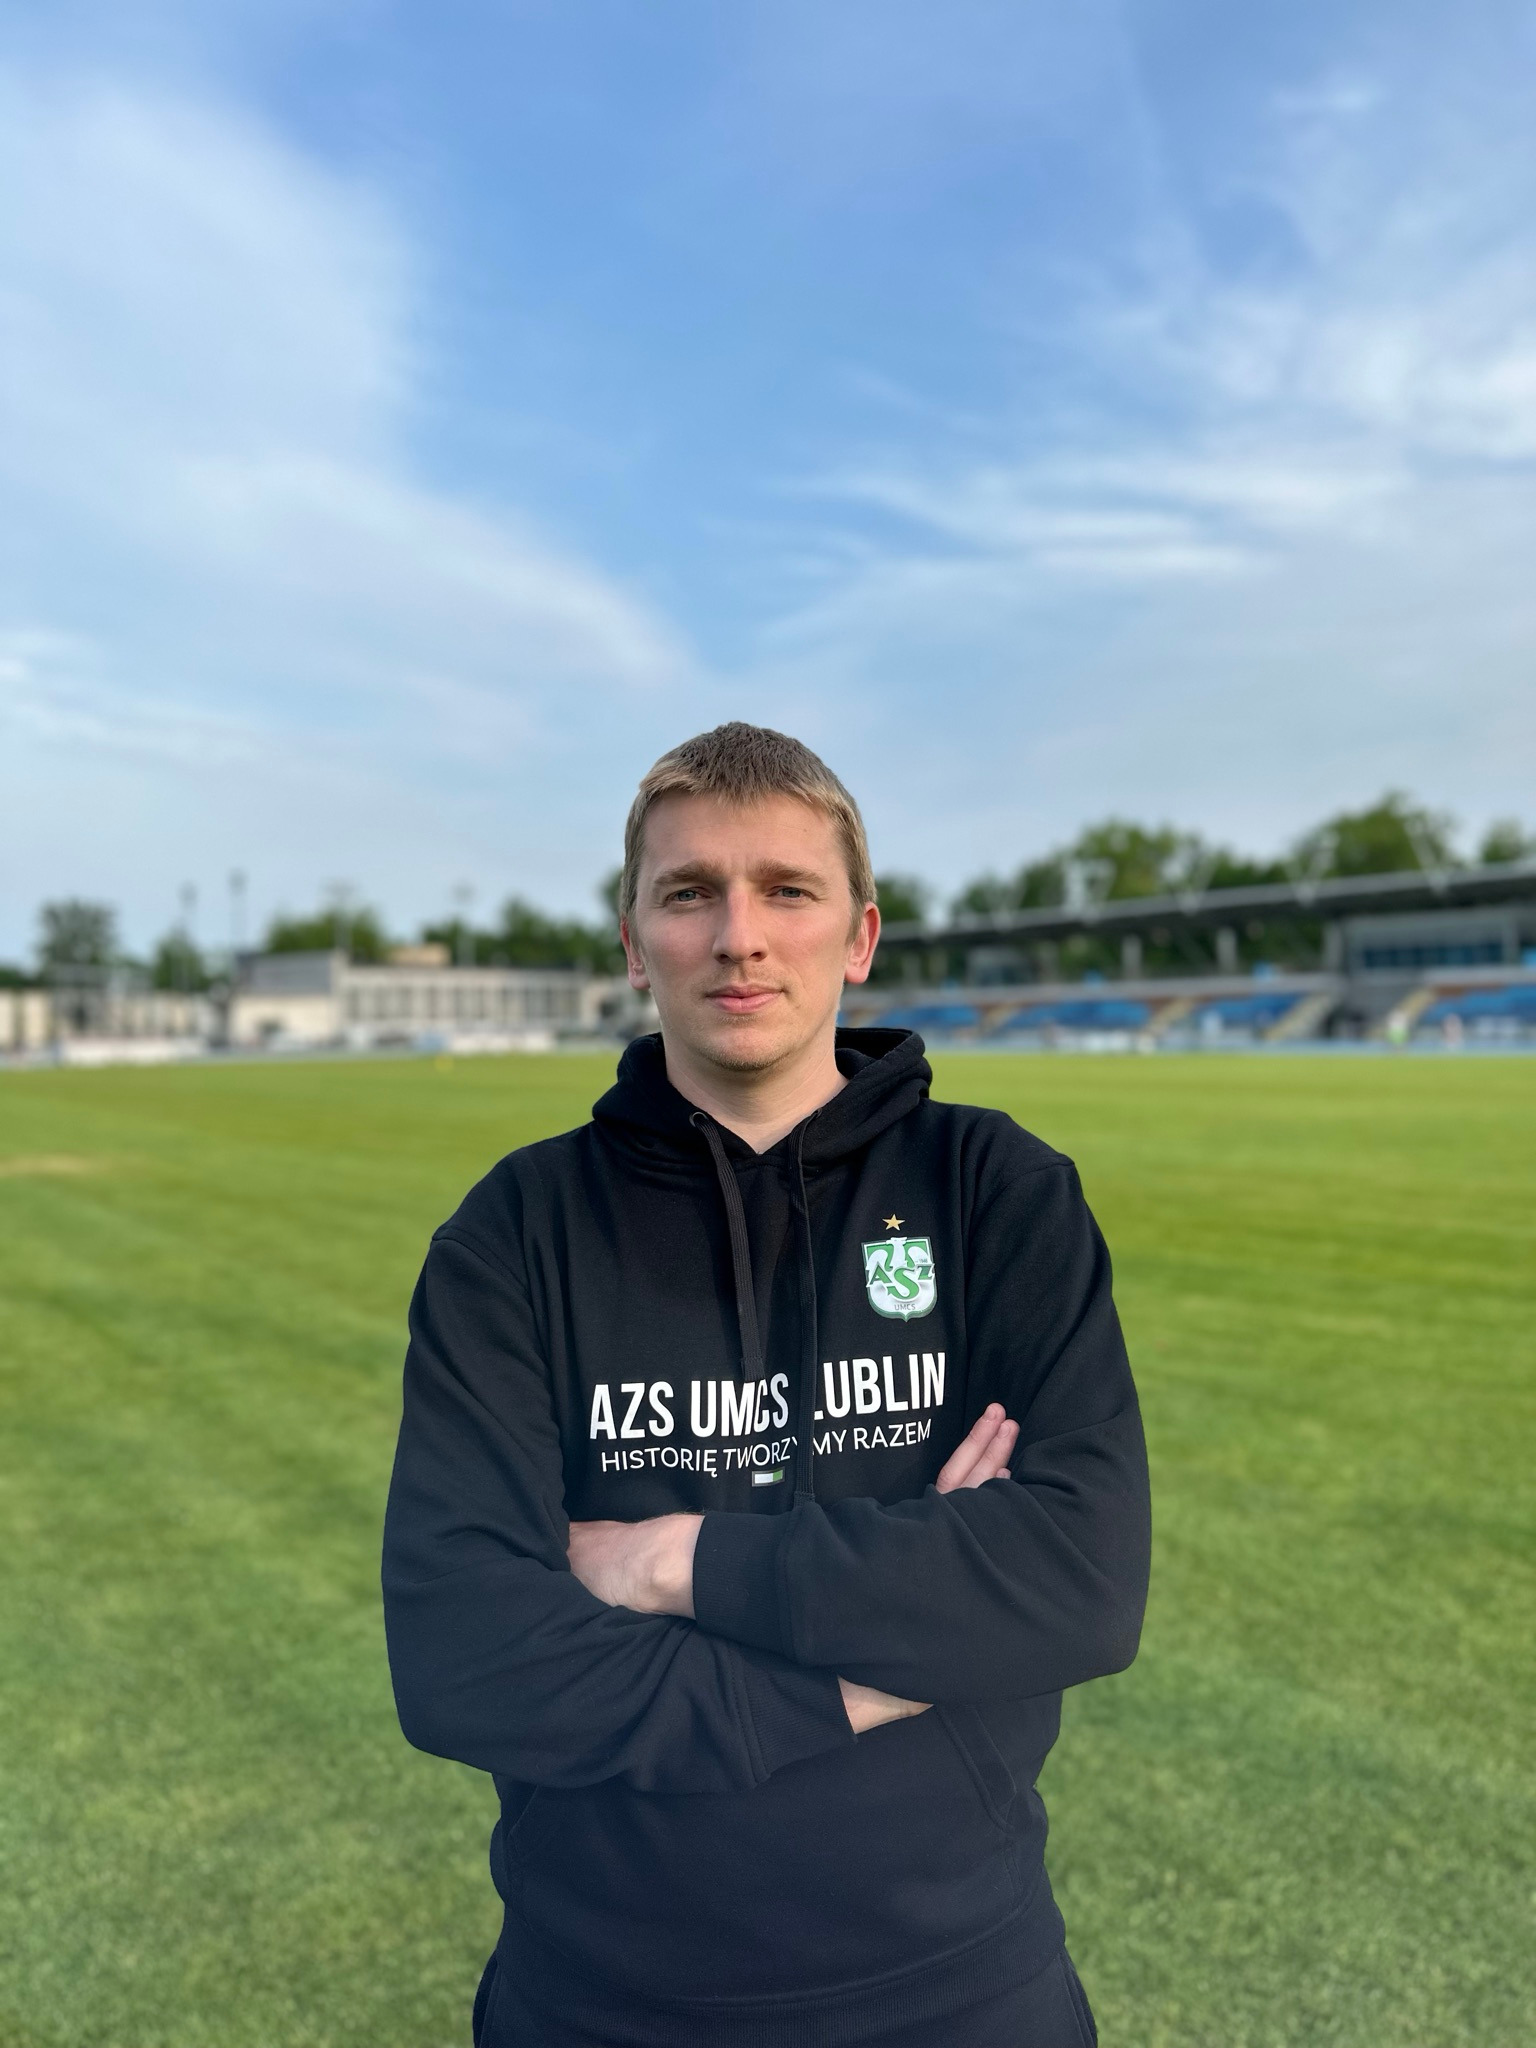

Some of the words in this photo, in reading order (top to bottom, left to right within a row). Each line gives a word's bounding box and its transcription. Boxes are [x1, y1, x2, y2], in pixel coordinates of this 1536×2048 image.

[894, 1303, 916, 1311] UMCS
[590, 1380, 675, 1440] AZS
[690, 1372, 789, 1437] UMCS
[813, 1352, 946, 1420] UBLIN
[601, 1447, 718, 1477] HISTORIĘ
[722, 1430, 848, 1470] TWORZMY
[854, 1418, 932, 1450] RAZEM
